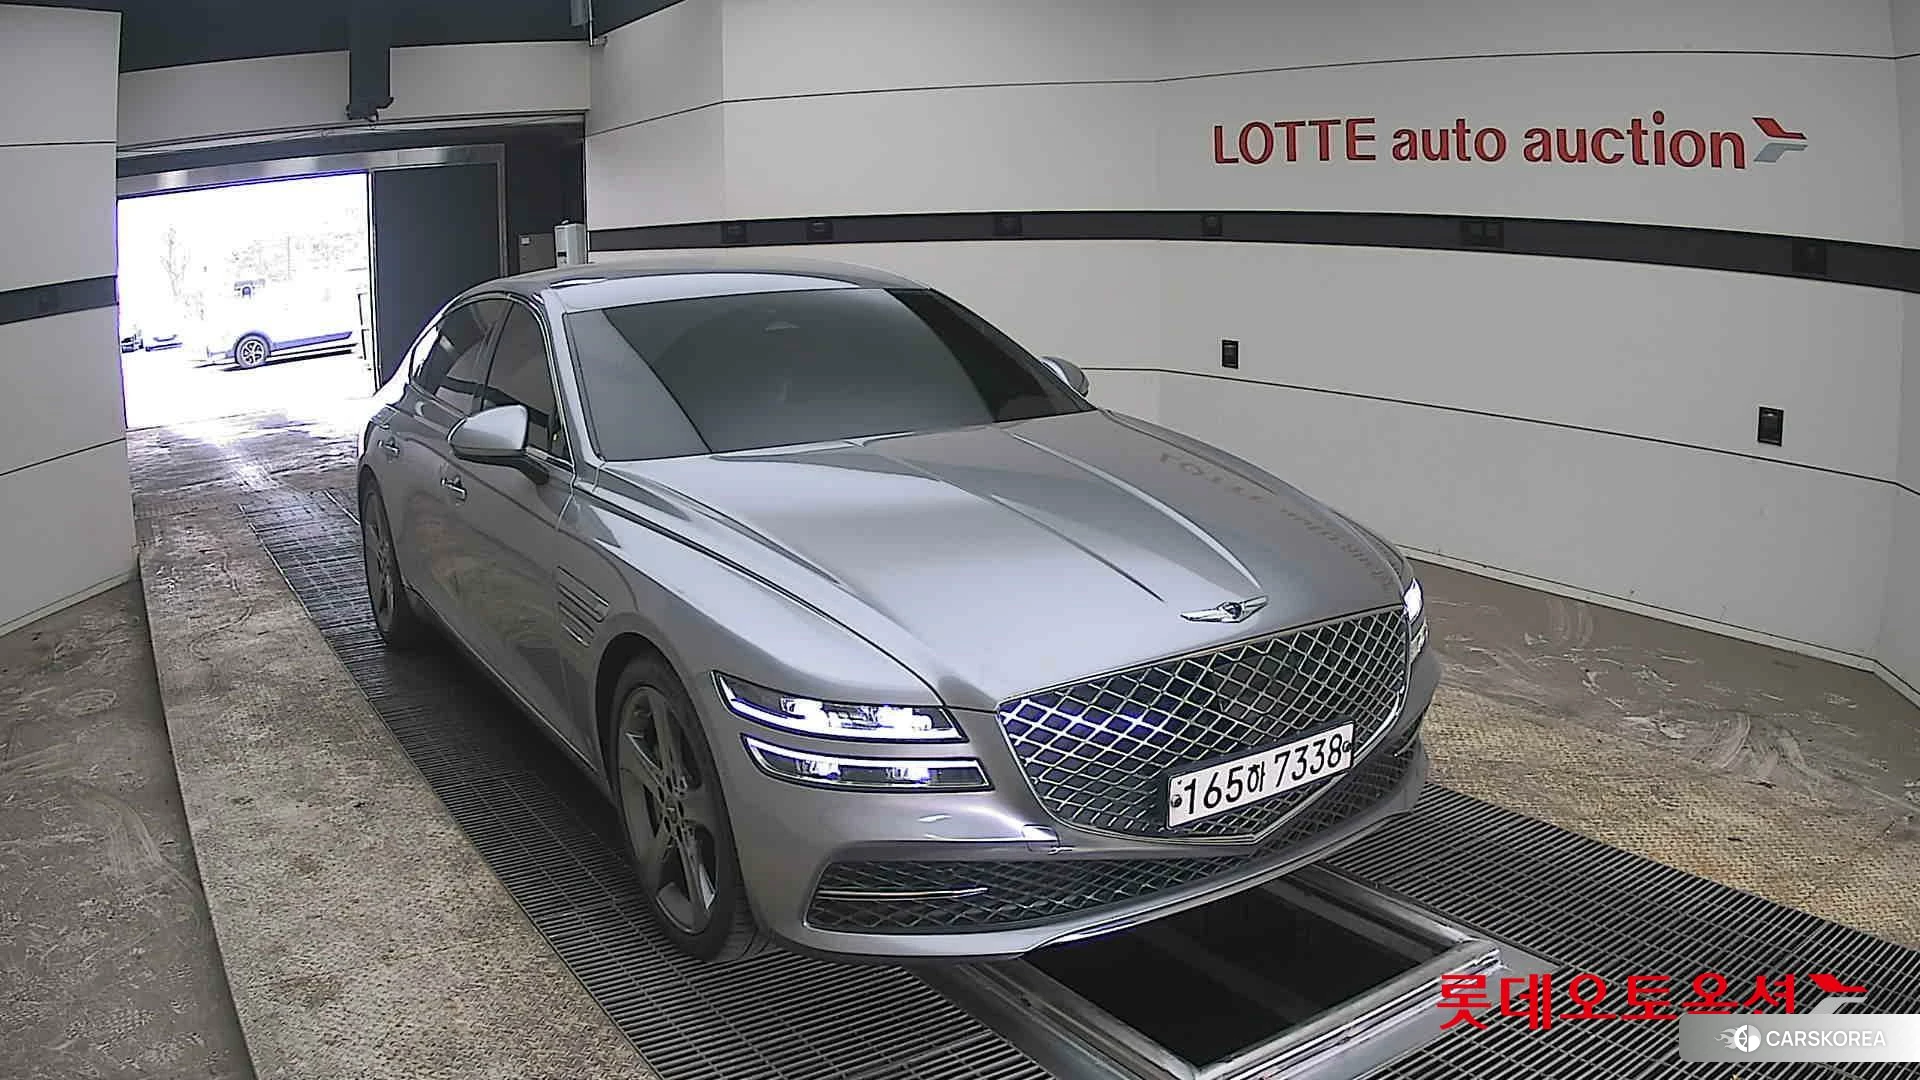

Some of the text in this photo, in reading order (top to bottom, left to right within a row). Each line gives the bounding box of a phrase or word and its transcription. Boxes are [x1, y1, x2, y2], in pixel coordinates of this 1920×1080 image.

[1212, 110, 1747, 170] LOTTE auto auction
[1183, 733, 1344, 815] 165하 7338
